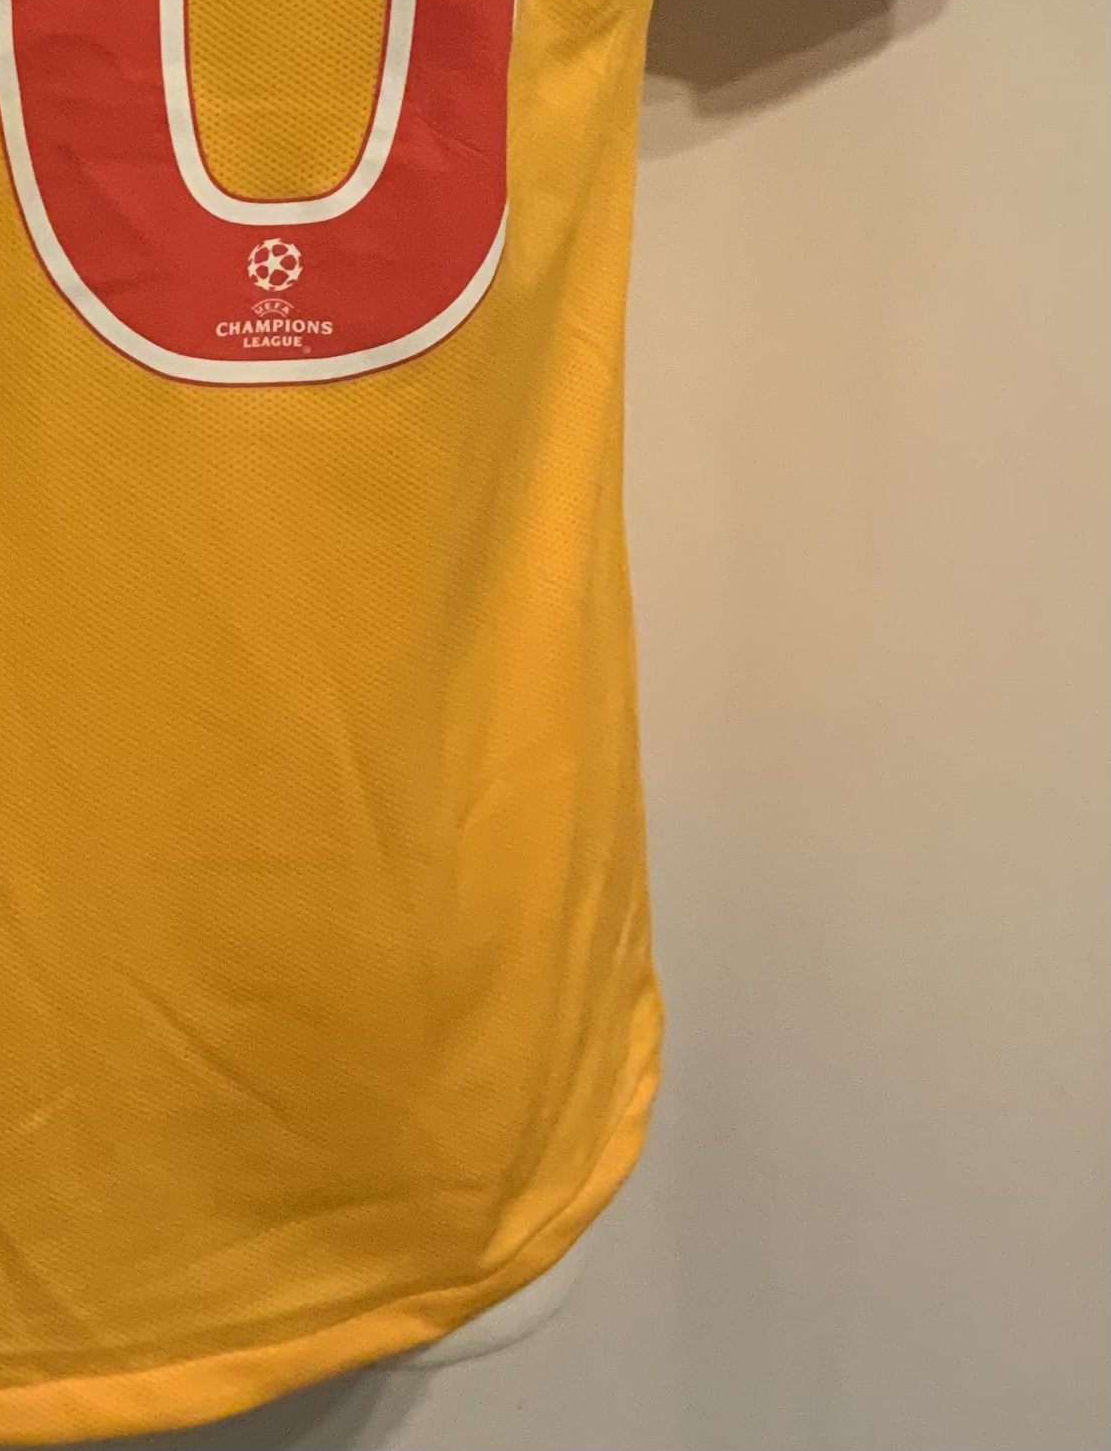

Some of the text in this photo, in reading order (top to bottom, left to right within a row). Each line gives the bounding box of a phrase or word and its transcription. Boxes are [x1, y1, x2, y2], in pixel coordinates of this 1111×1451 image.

[252, 302, 290, 315] UEFA
[215, 319, 334, 336] CHAMPIONS
[242, 336, 303, 348] LEAGUE
